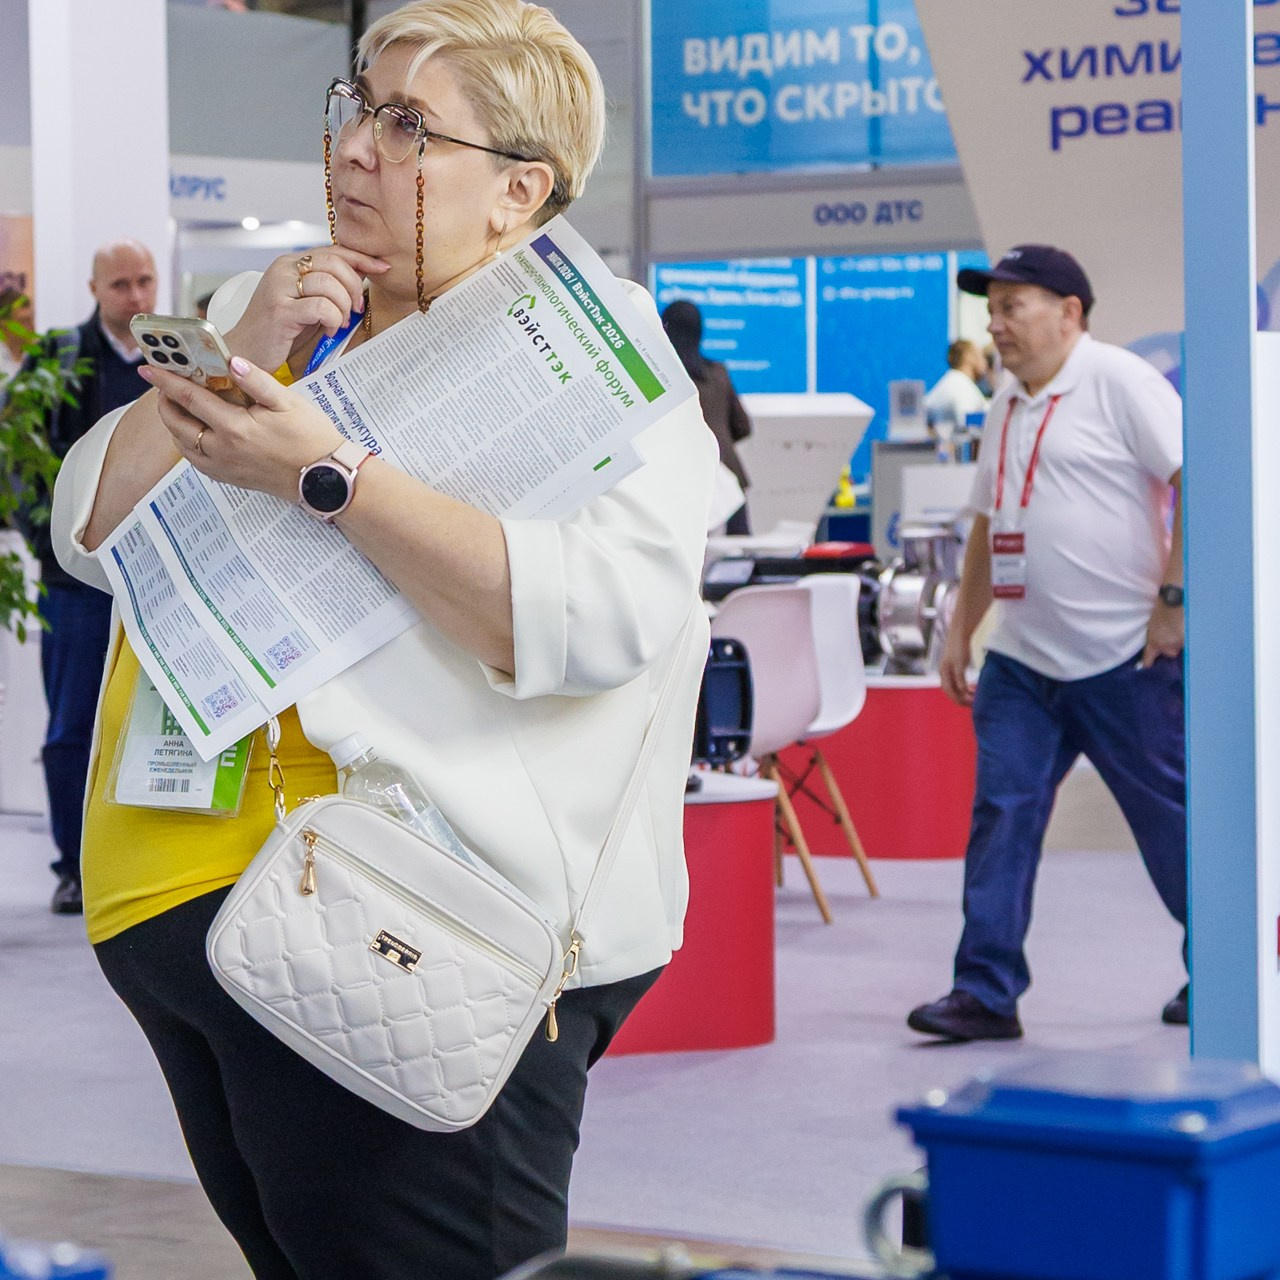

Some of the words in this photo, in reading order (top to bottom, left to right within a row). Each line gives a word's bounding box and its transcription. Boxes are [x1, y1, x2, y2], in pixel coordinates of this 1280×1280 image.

[683, 28, 841, 80] ВИДИМ
[847, 22, 921, 66] ТО,
[682, 88, 767, 127] ЧТО
[813, 202, 868, 226] ООО
[874, 199, 923, 226] ДТС
[512, 249, 603, 360] Инженерно-технологический
[594, 357, 636, 409] форум
[571, 281, 606, 327] ВэйстТэк
[601, 322, 626, 350] 2026
[512, 308, 574, 386] ВЭЙСТТЭК
[306, 381, 320, 400] для
[315, 394, 340, 424] развития
[324, 370, 345, 398] Водная
[340, 396, 383, 457] инфраструктура
[154, 749, 193, 757] ЛЕТЯГИНА
[163, 740, 184, 748] АННА
